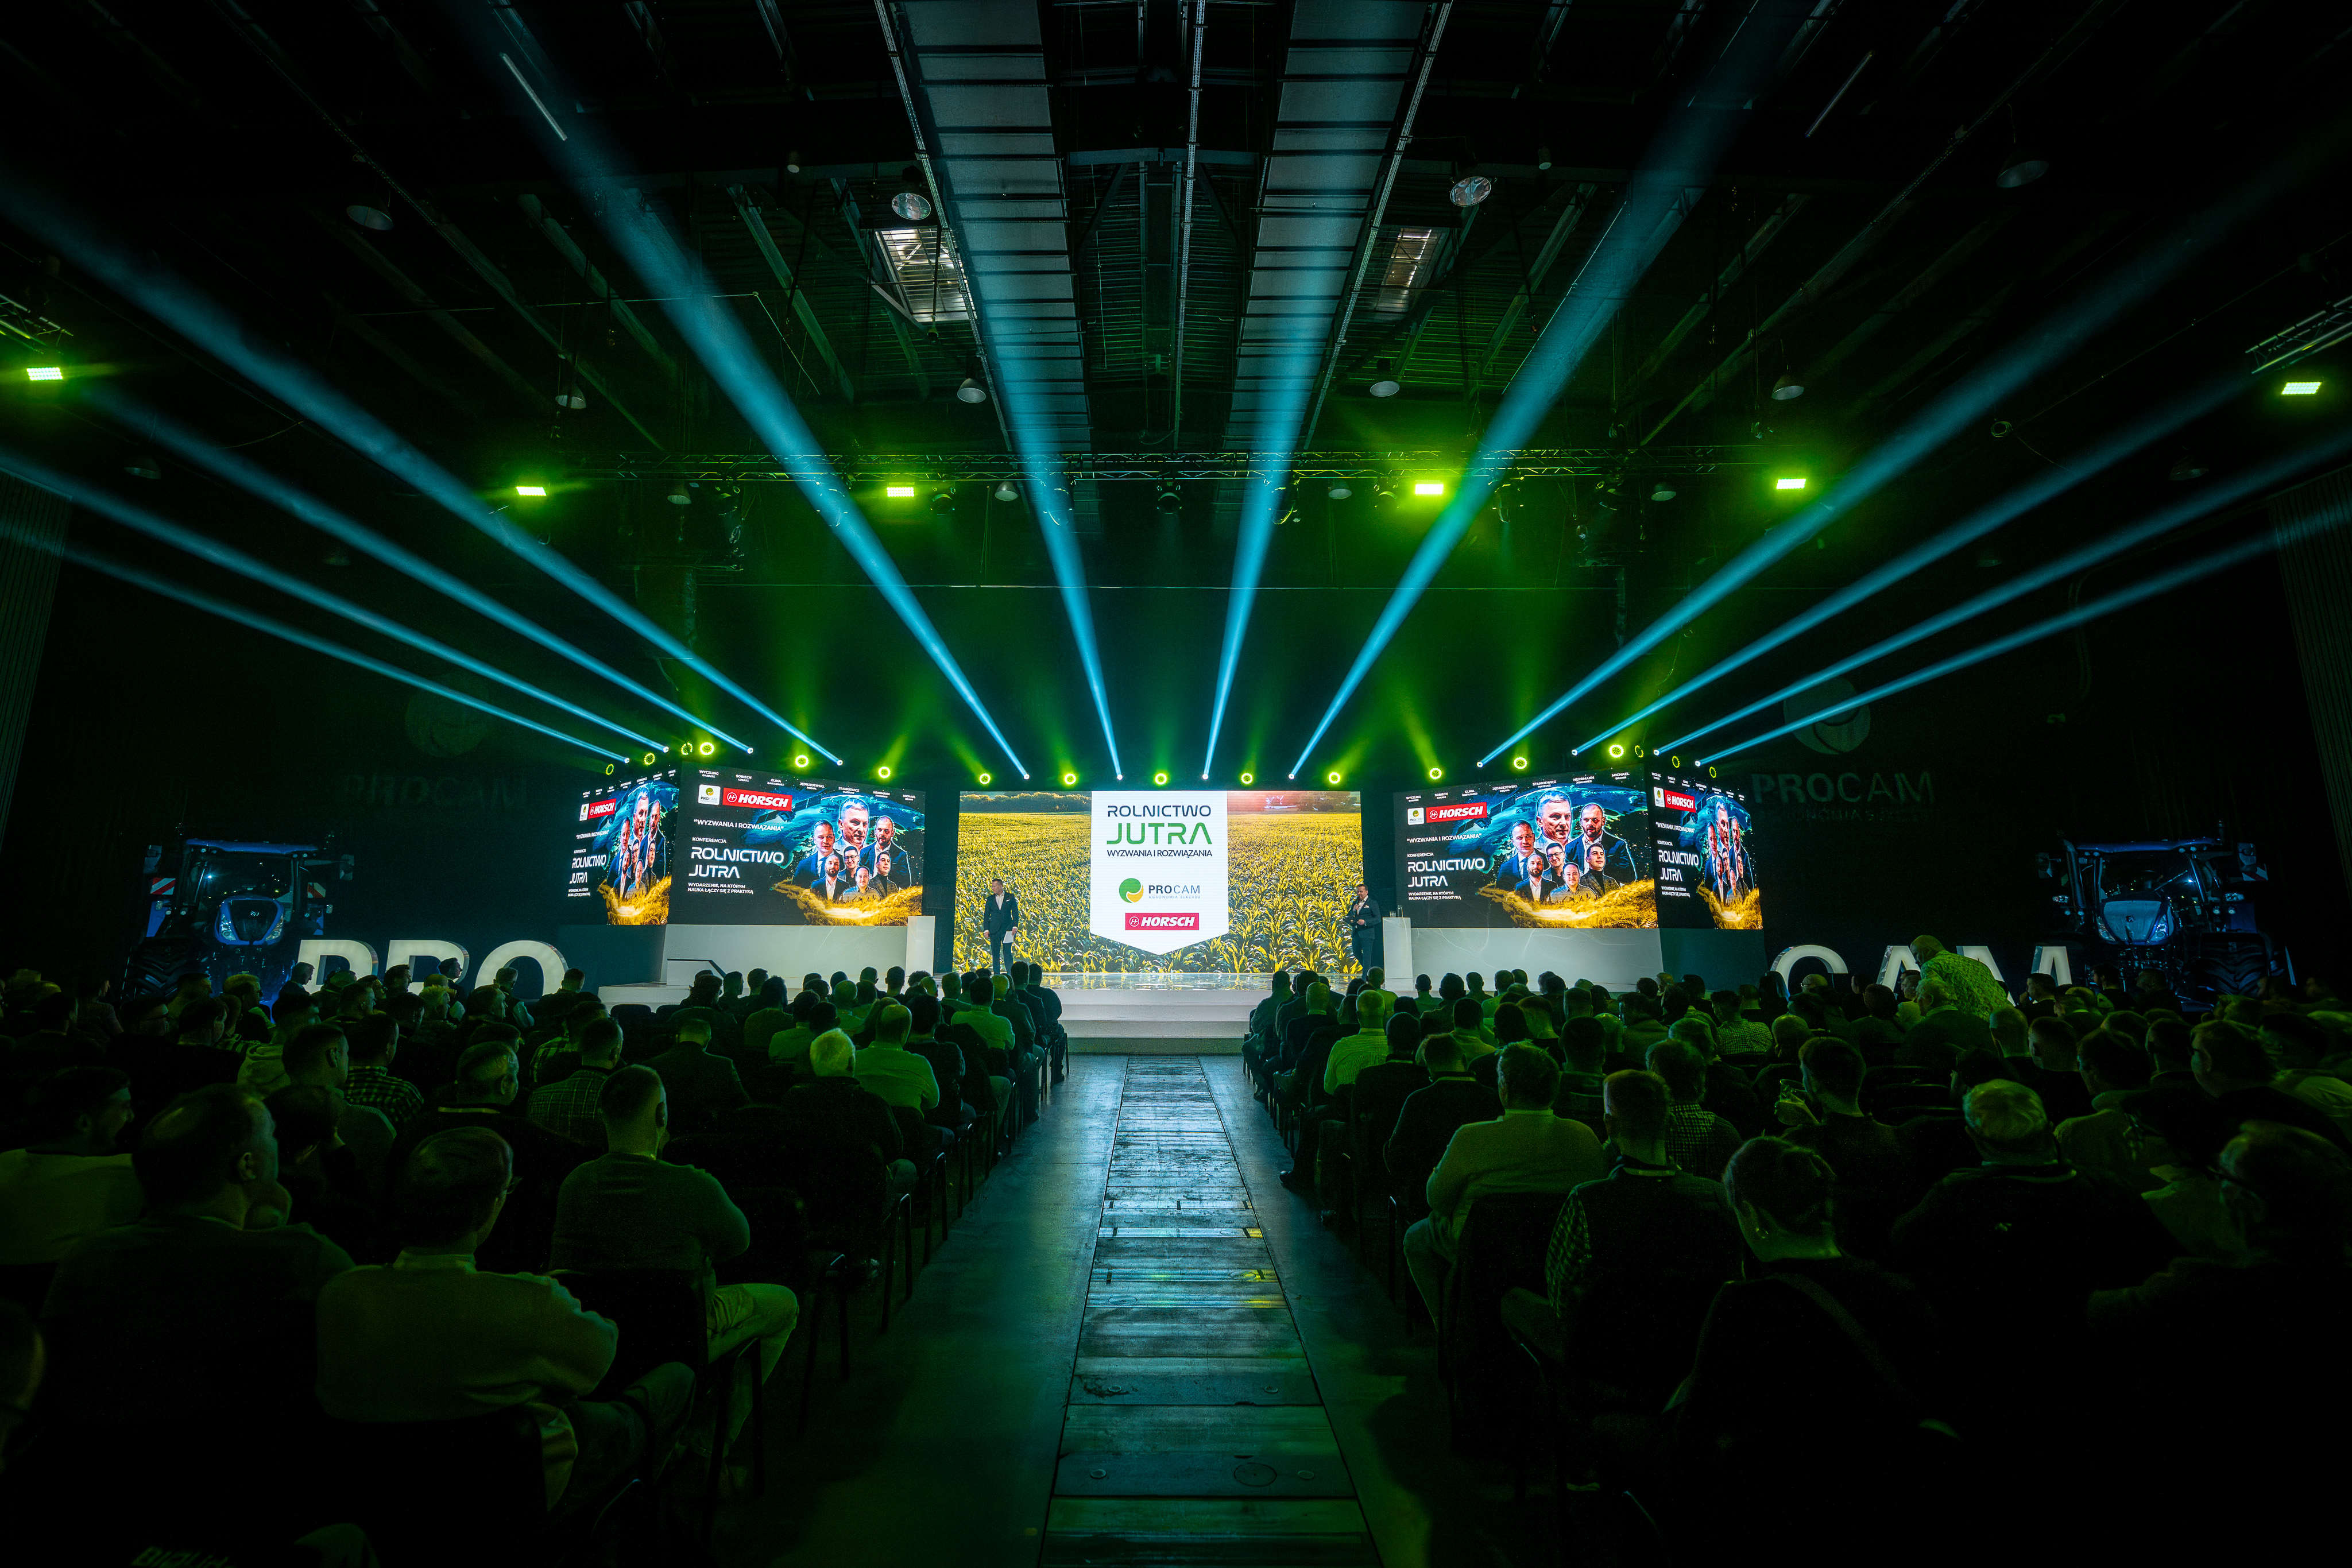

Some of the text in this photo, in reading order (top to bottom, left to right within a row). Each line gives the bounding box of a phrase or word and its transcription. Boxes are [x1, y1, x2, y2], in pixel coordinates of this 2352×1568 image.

[1751, 772, 1935, 803] PROCAM
[738, 793, 788, 807] HORSCH
[1672, 795, 1694, 809] HORSCH
[594, 803, 614, 815] HORSCH
[1108, 806, 1211, 816] ROLNICTWO
[1439, 806, 1483, 818] HORSCH
[1107, 822, 1212, 845] JUTRA
[691, 846, 784, 864] ROLNICTWO
[1157, 850, 1212, 858] ROZWIĄZANIA
[1658, 850, 1699, 866] ROLNICTWO
[572, 854, 606, 869] ROLNICTWO
[1408, 858, 1485, 872] ROLNICTWO
[688, 864, 740, 878] JUTRA
[1660, 868, 1682, 881] JUTRA
[569, 872, 587, 884] JUTRA
[1408, 876, 1448, 887] JUTRA
[1149, 885, 1200, 894] PROCAM
[1141, 916, 1195, 926] HORSCH
